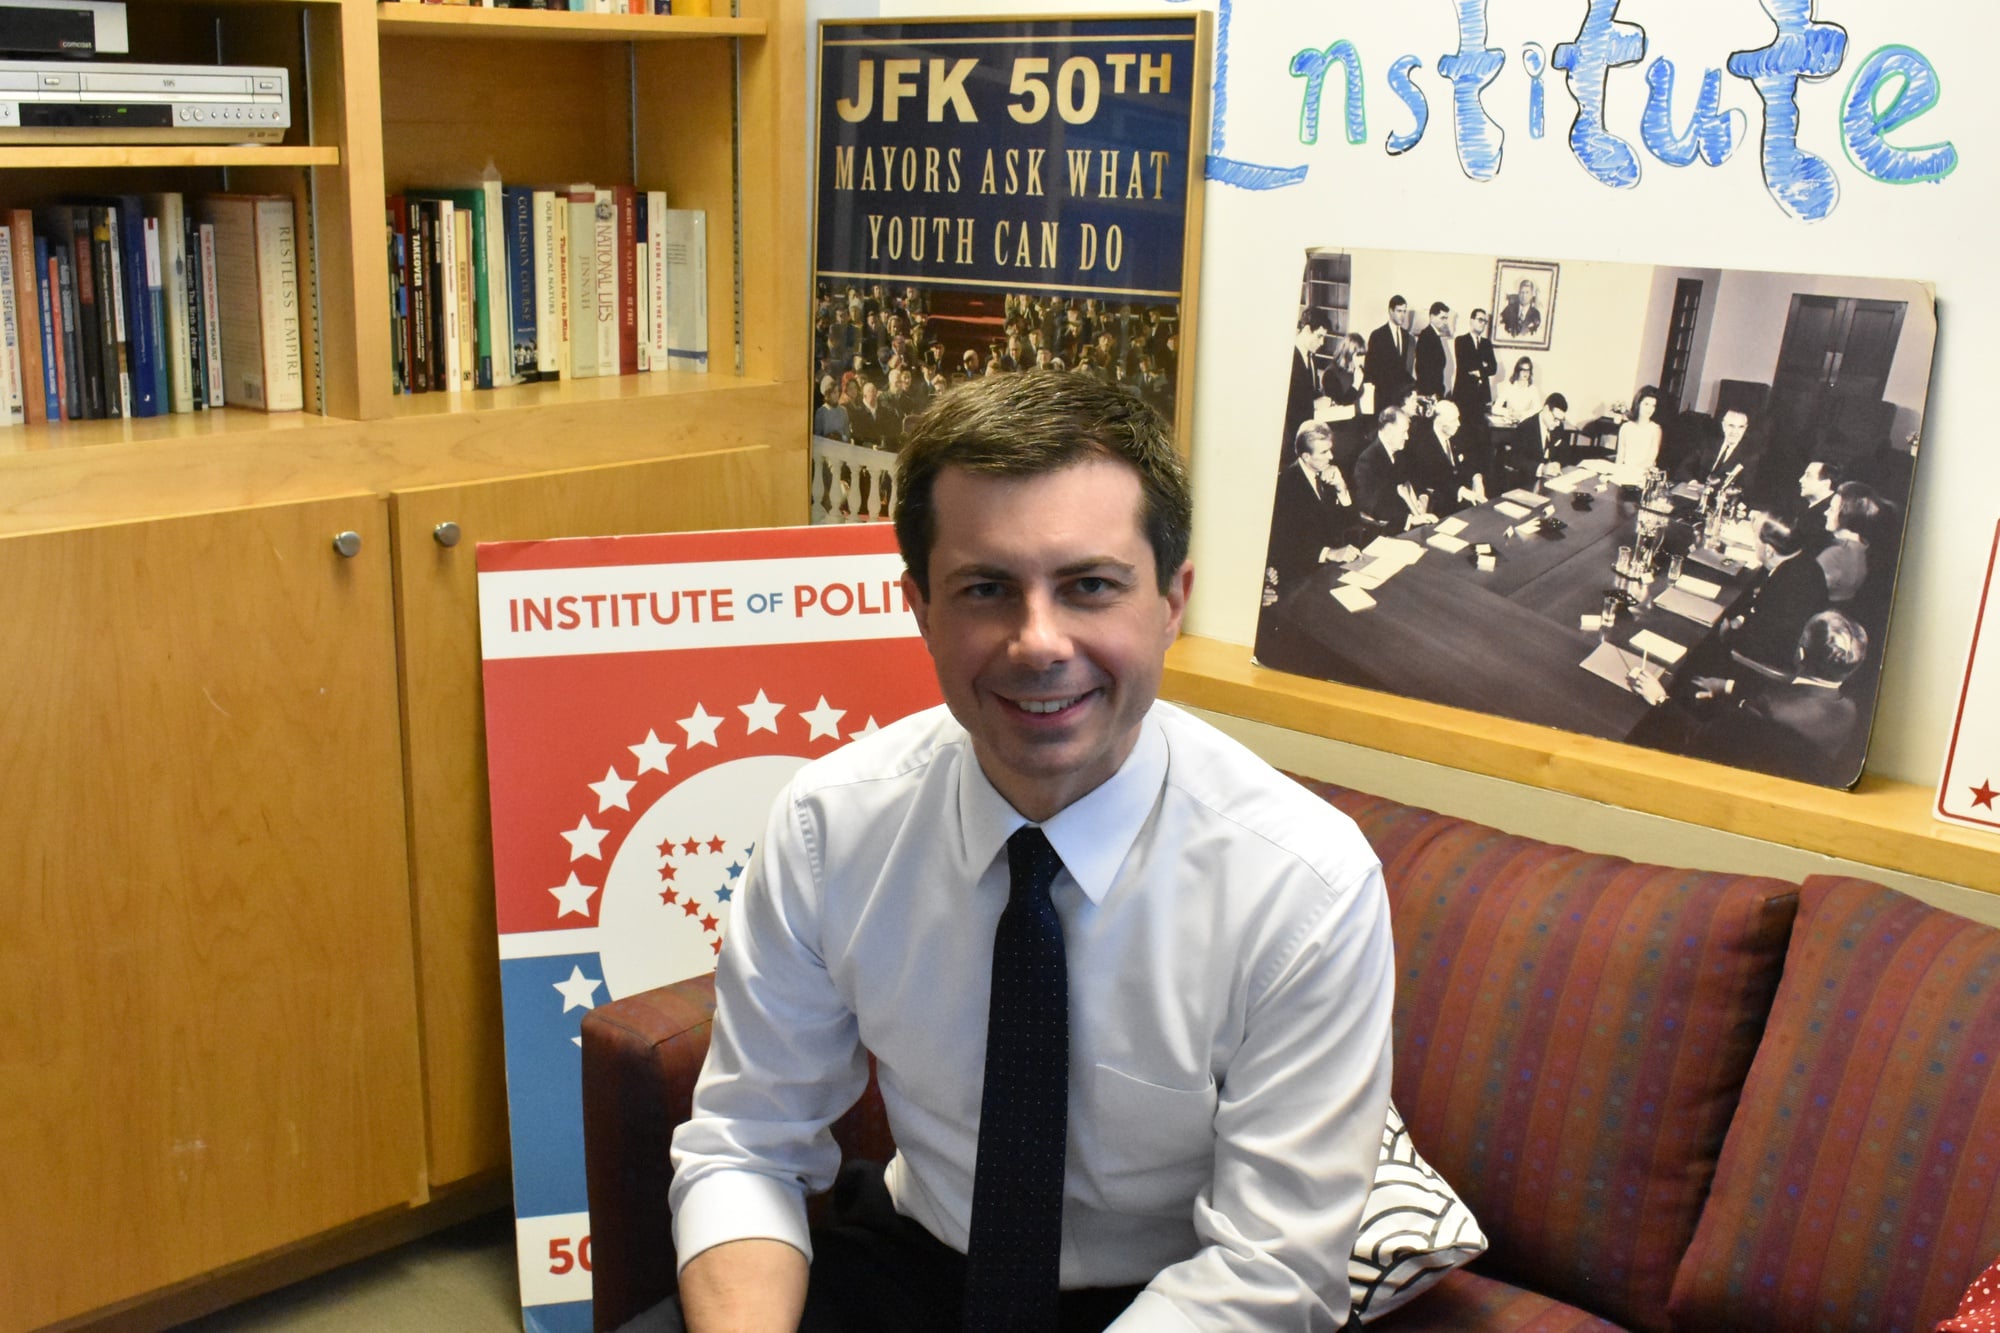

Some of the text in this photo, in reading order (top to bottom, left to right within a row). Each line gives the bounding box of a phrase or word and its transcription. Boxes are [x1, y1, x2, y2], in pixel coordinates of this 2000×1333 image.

[61, 41, 92, 49] comcast
[836, 53, 1173, 125] JFK 50TH
[834, 145, 1170, 200] MAYORS ASK WHAT
[517, 196, 529, 267] COLLISION
[546, 225, 554, 273] POLITICAL
[868, 215, 1123, 272] YOUTH CAN DO
[412, 234, 422, 286] TAKEOVER
[579, 256, 591, 310] JINNAH
[597, 225, 613, 322] NATIONAL LIES
[3, 289, 15, 347] DYSFUNCTION
[190, 306, 198, 324] Birth
[279, 226, 299, 381] RESTLESS EMPIRE
[521, 271, 531, 321] COURSE
[548, 277, 556, 315] NATURE
[191, 326, 198, 334] of
[191, 336, 199, 359] Power
[509, 580, 910, 633] INSTITUTE OF POLIT
